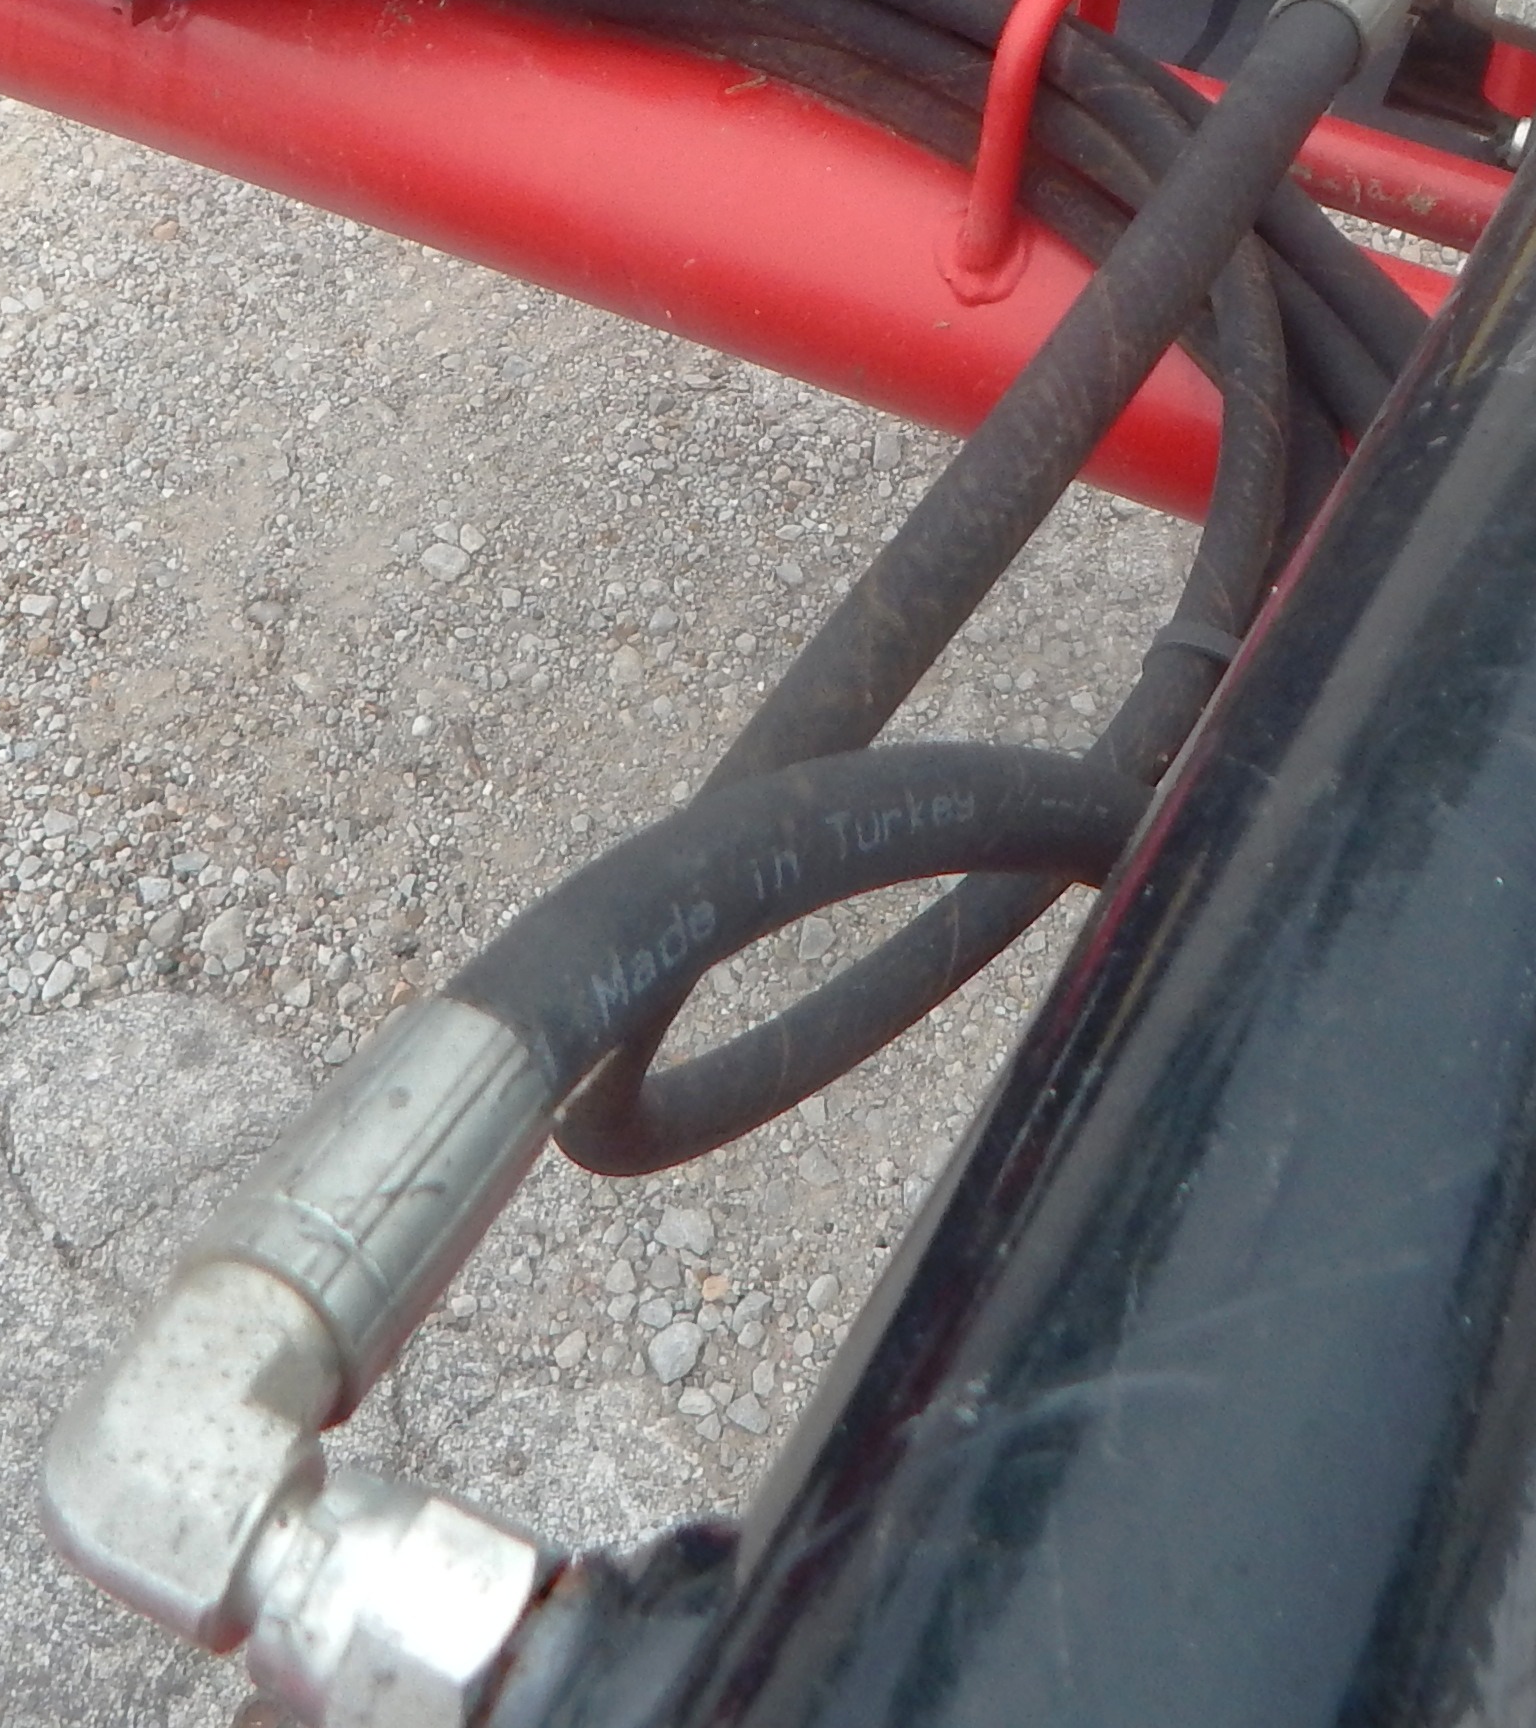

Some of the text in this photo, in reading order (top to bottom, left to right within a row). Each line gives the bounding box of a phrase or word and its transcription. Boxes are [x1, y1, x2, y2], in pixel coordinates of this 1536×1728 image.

[589, 899, 717, 1028] Made
[749, 845, 802, 900] in
[824, 789, 976, 861] Turkey
